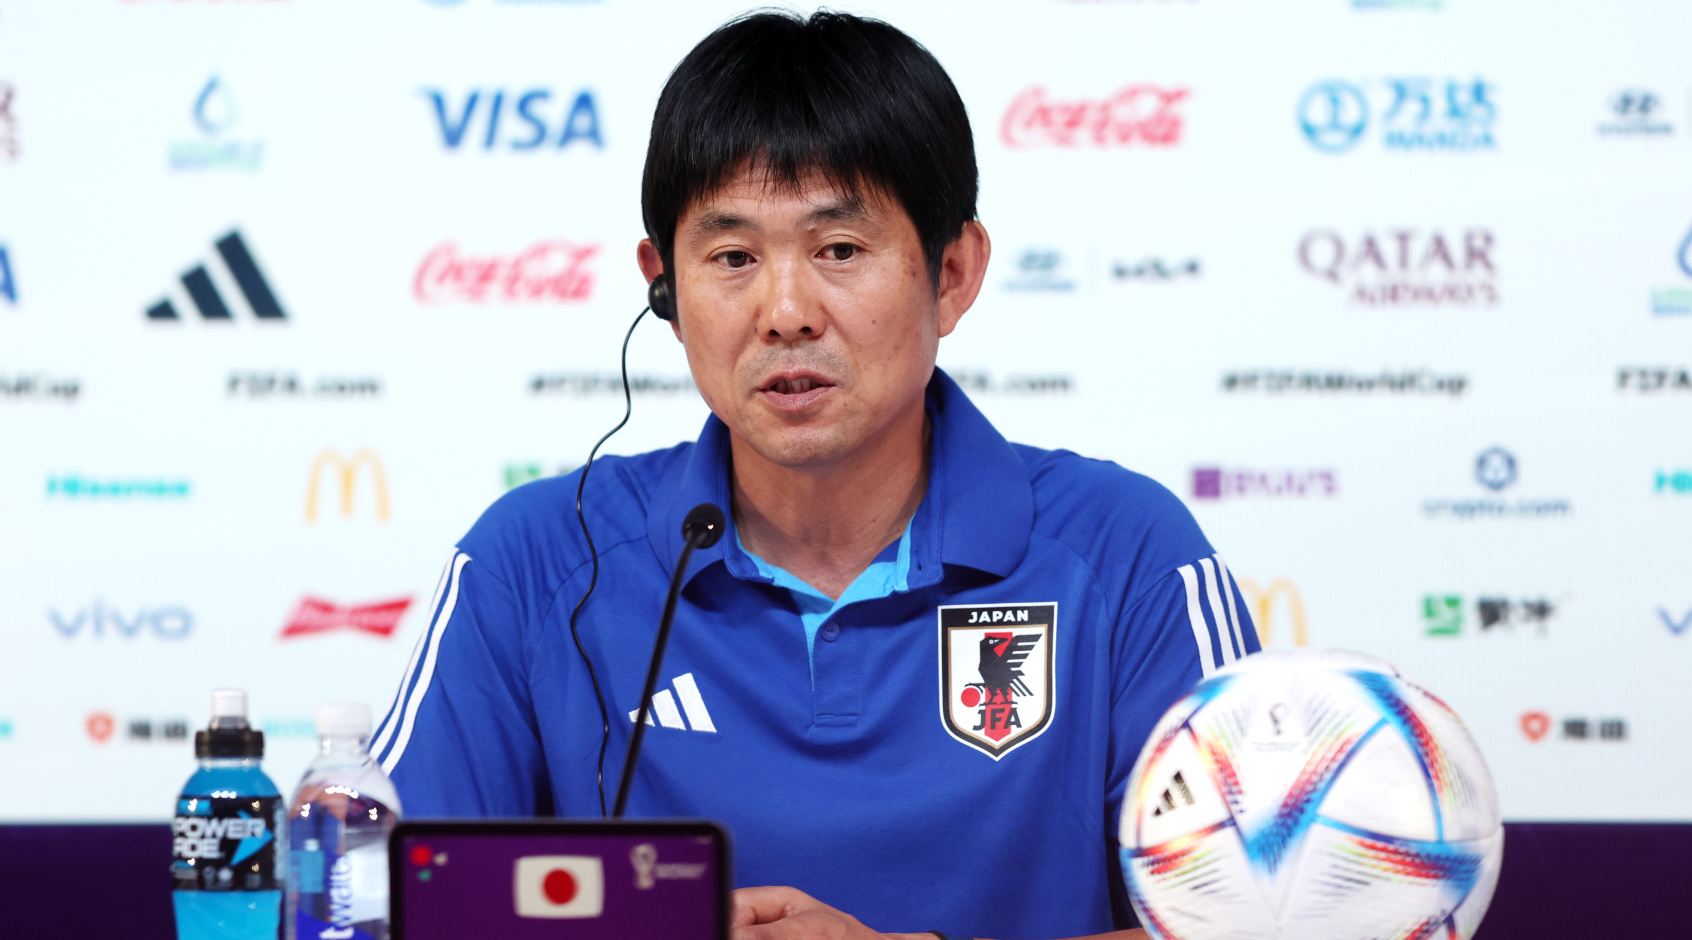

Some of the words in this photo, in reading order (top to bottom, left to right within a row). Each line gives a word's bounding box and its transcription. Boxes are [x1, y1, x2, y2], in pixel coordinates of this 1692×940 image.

[420, 87, 604, 150] VISA
[1298, 228, 1496, 284] QATAR
[1350, 283, 1501, 307] AIRWAYS
[226, 372, 382, 397] FIFA.com
[1221, 370, 1469, 397] #FIFAWorldCup
[46, 475, 191, 498] Hisense
[48, 599, 195, 641] vivo
[968, 610, 1029, 624] JAPAN
[972, 708, 1023, 731] JFA
[174, 817, 266, 839] POWER
